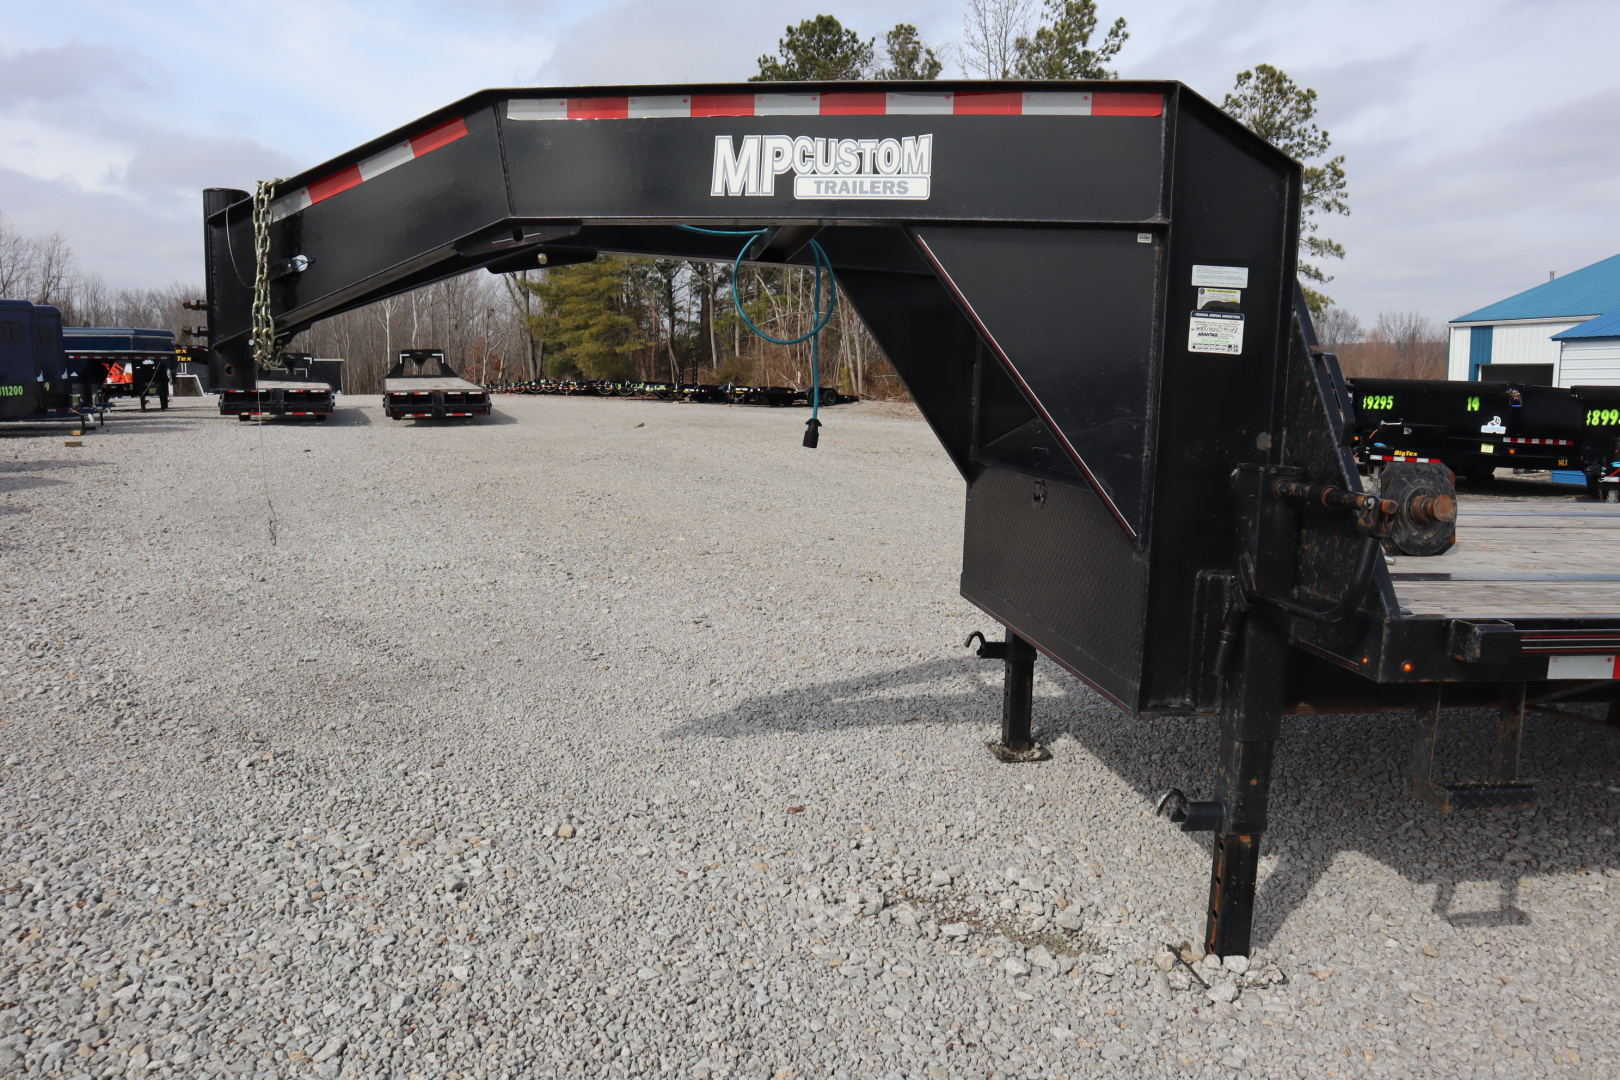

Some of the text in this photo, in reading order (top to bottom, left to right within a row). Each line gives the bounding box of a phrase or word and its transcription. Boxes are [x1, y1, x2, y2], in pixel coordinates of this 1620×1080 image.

[814, 180, 909, 195] TRAILERS
[1363, 395, 1394, 410] $9295
[1467, 396, 1480, 411] 14
[1586, 409, 1620, 426] $899
